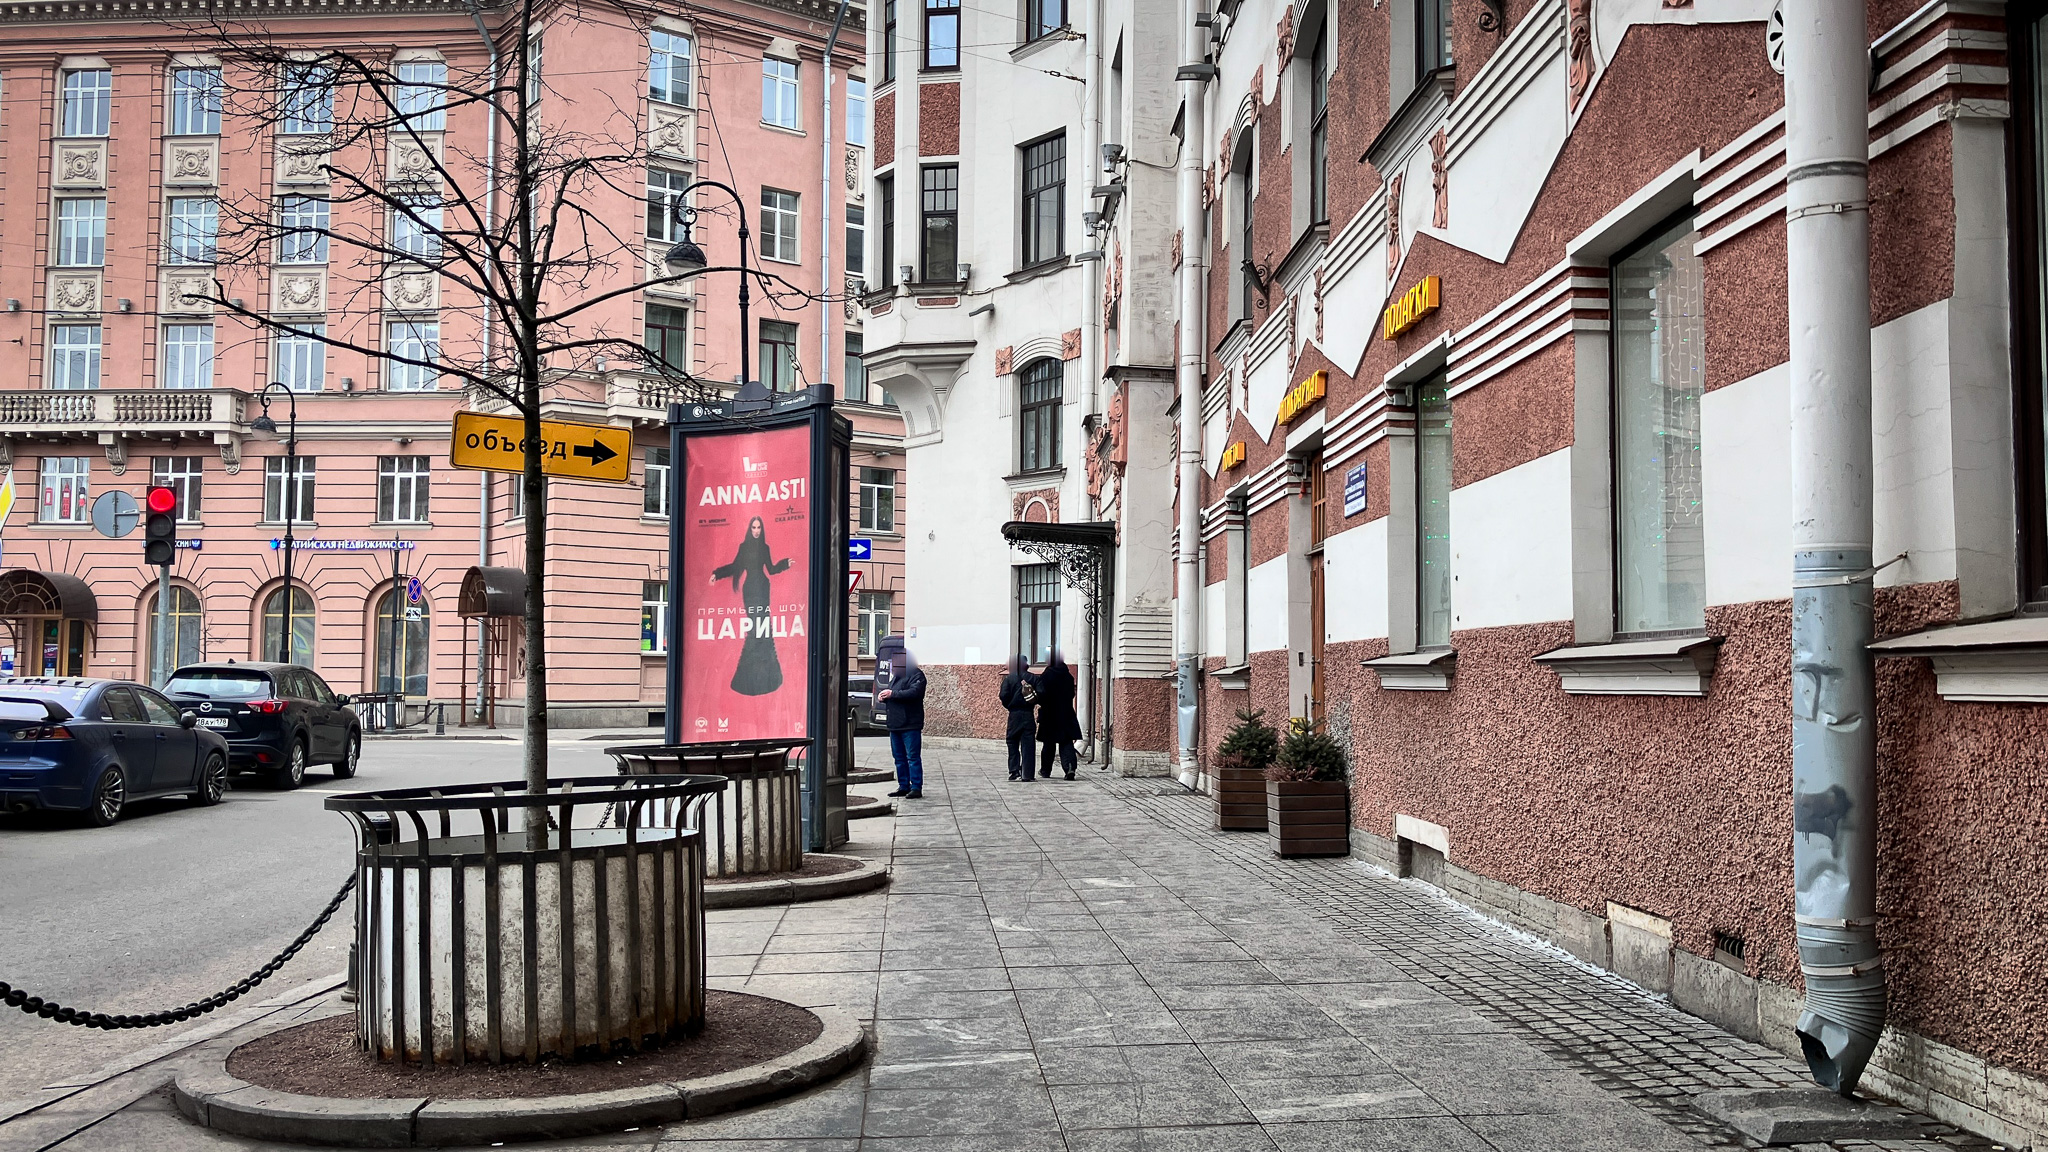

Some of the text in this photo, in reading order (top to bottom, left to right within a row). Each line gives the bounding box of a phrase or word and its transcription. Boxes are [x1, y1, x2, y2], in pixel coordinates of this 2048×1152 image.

[1384, 275, 1429, 340] ПОДАРКИ
[699, 477, 805, 506] ANNA ASTI
[280, 538, 414, 549] БЛТИЙСКАЯ НЕДВИЖИМОСТЬ
[697, 603, 805, 615] ПРЕМЬЕРА ШОУ
[697, 614, 805, 640] ЦАРИЦА
[794, 722, 804, 732] 12+
